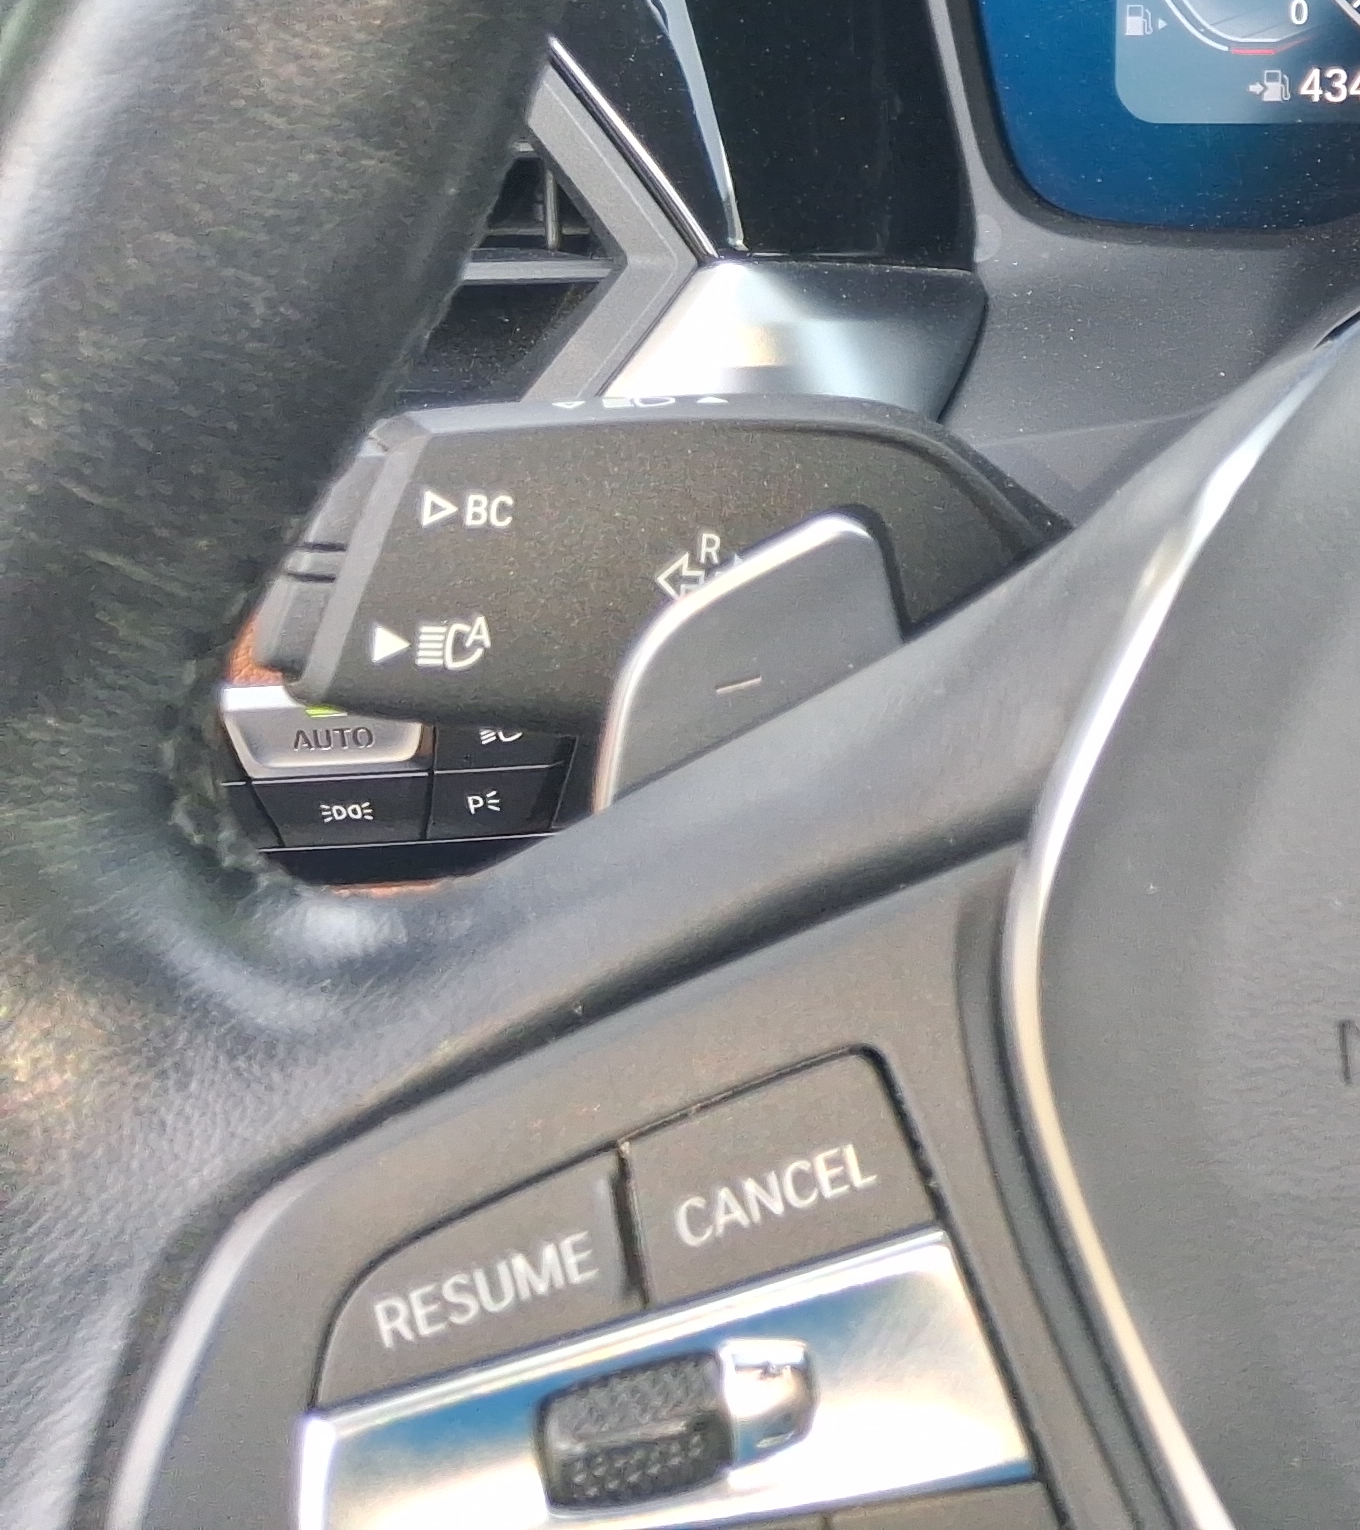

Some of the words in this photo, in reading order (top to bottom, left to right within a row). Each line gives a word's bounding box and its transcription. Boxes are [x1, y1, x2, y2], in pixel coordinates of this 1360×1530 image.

[1289, 0, 1309, 26] 0
[465, 494, 513, 528] BC
[700, 533, 720, 563] R
[292, 725, 373, 751] AUTO
[468, 793, 484, 813] P
[673, 1142, 877, 1246] CANCEL
[374, 1231, 600, 1350] RESUME
